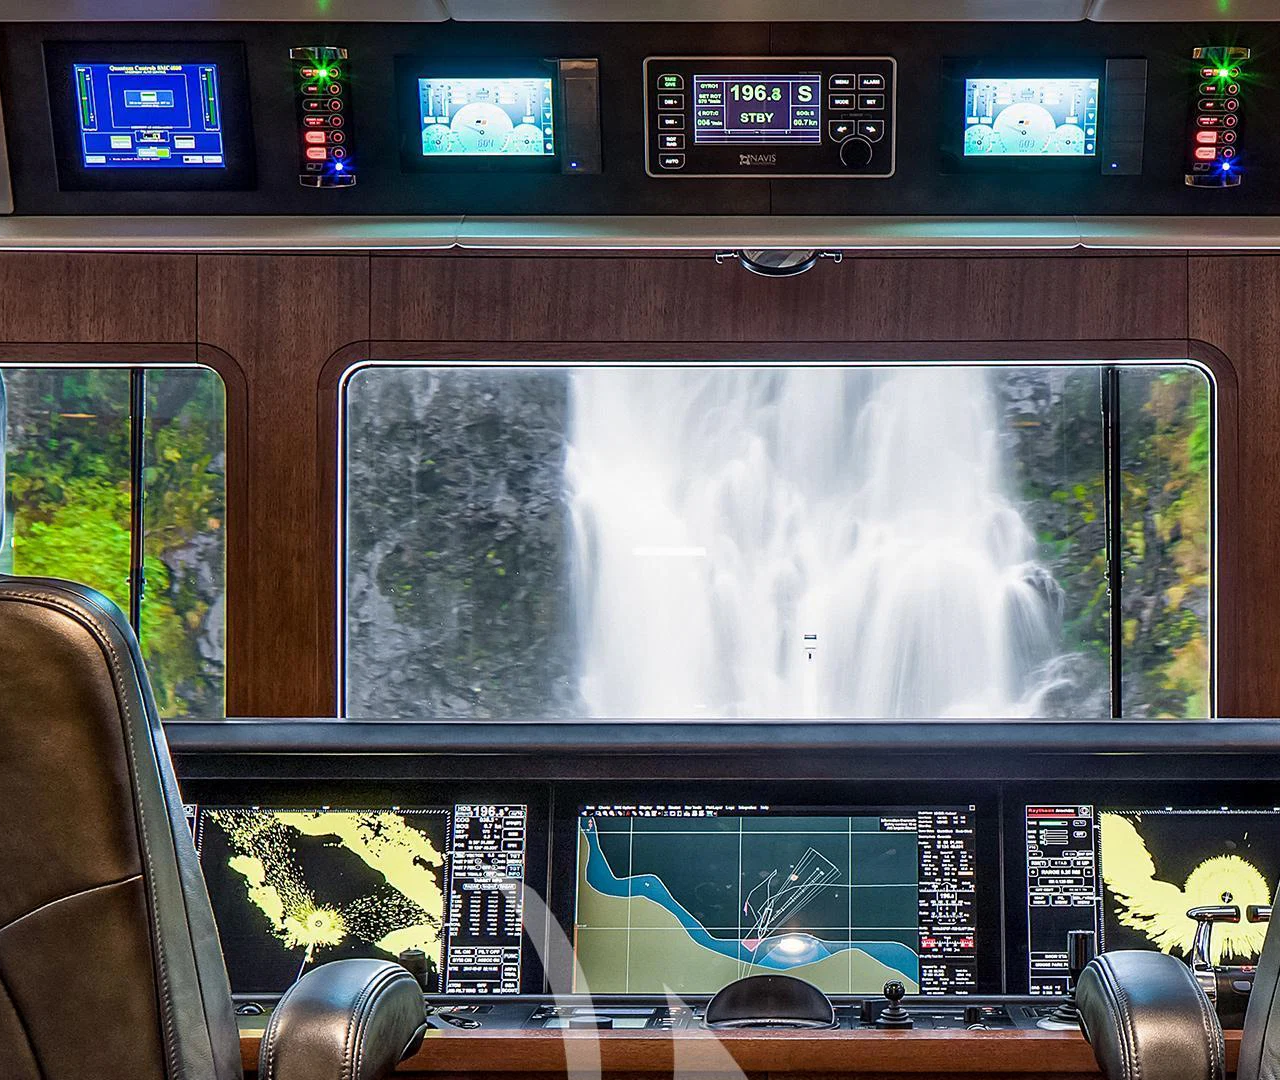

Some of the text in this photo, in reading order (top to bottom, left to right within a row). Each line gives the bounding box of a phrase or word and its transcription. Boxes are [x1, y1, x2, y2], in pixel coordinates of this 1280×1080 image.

[730, 84, 782, 101] 196.8
[797, 85, 813, 102] S
[740, 113, 775, 123] STBY
[750, 154, 776, 162] NAVIS
